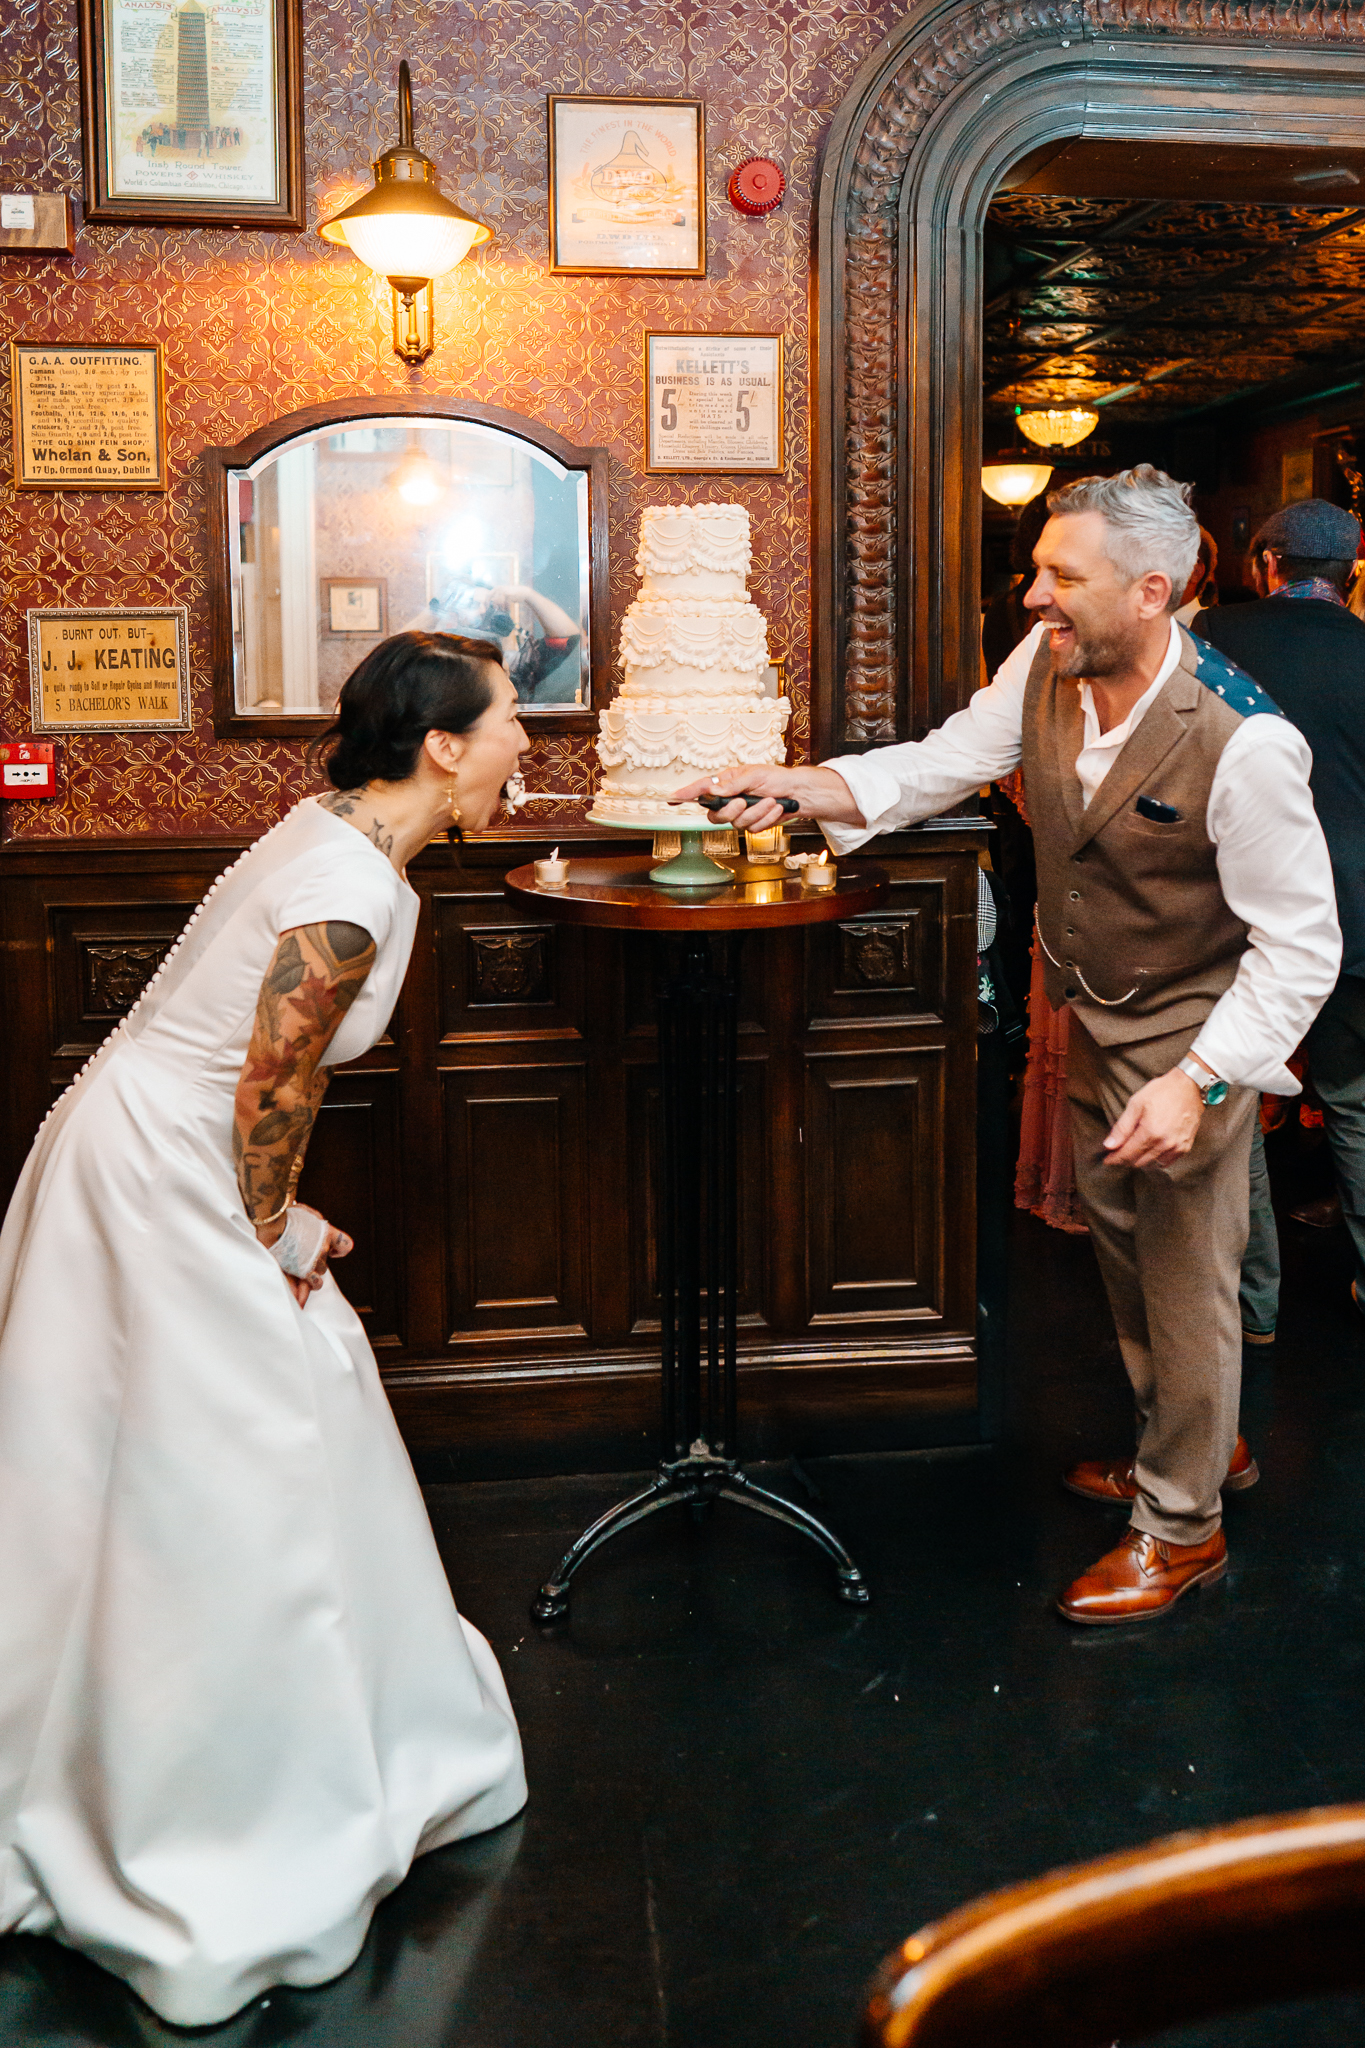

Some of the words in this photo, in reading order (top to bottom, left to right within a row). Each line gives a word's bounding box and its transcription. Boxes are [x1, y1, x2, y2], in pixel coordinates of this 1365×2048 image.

[124, 2, 172, 11] ANALYSIS
[211, 6, 261, 15] ANALYSIS
[580, 137, 594, 154] THE
[593, 120, 621, 140] FINEST
[623, 120, 633, 128] IN
[636, 120, 653, 133] THE
[654, 129, 677, 157] WORLD
[148, 161, 169, 169] Irish
[175, 161, 205, 170] Round
[149, 179, 181, 187] Columbian
[70, 356, 142, 365] OUTFITTING.
[676, 360, 750, 375] KELLETT'S
[655, 376, 700, 385] BUSINESS
[706, 377, 715, 386] IS
[720, 377, 733, 386] AS
[739, 377, 771, 387] USUAL.
[32, 448, 91, 461] Whelan
[98, 448, 111, 461] &
[117, 449, 150, 462] Son,
[32, 466, 41, 474] 17
[44, 466, 58, 475] Up.
[60, 466, 93, 474] Ormond
[95, 466, 121, 475] Quay,
[123, 466, 151, 474] Dublin
[62, 629, 93, 640] BURNT
[43, 650, 58, 671] J.
[67, 650, 82, 671] J.
[95, 648, 176, 670] KEATING
[44, 683, 49, 692] is
[54, 683, 66, 694] quite
[70, 682, 82, 693] ready
[84, 681, 89, 691] to
[91, 681, 100, 690] Sell
[110, 681, 125, 692] Repair
[127, 680, 142, 692] Cycles
[144, 680, 152, 689] and
[154, 680, 171, 689] Motors
[55, 699, 61, 712] 5
[69, 697, 130, 711] BACHELOR'S
[138, 696, 168, 710] WALK
